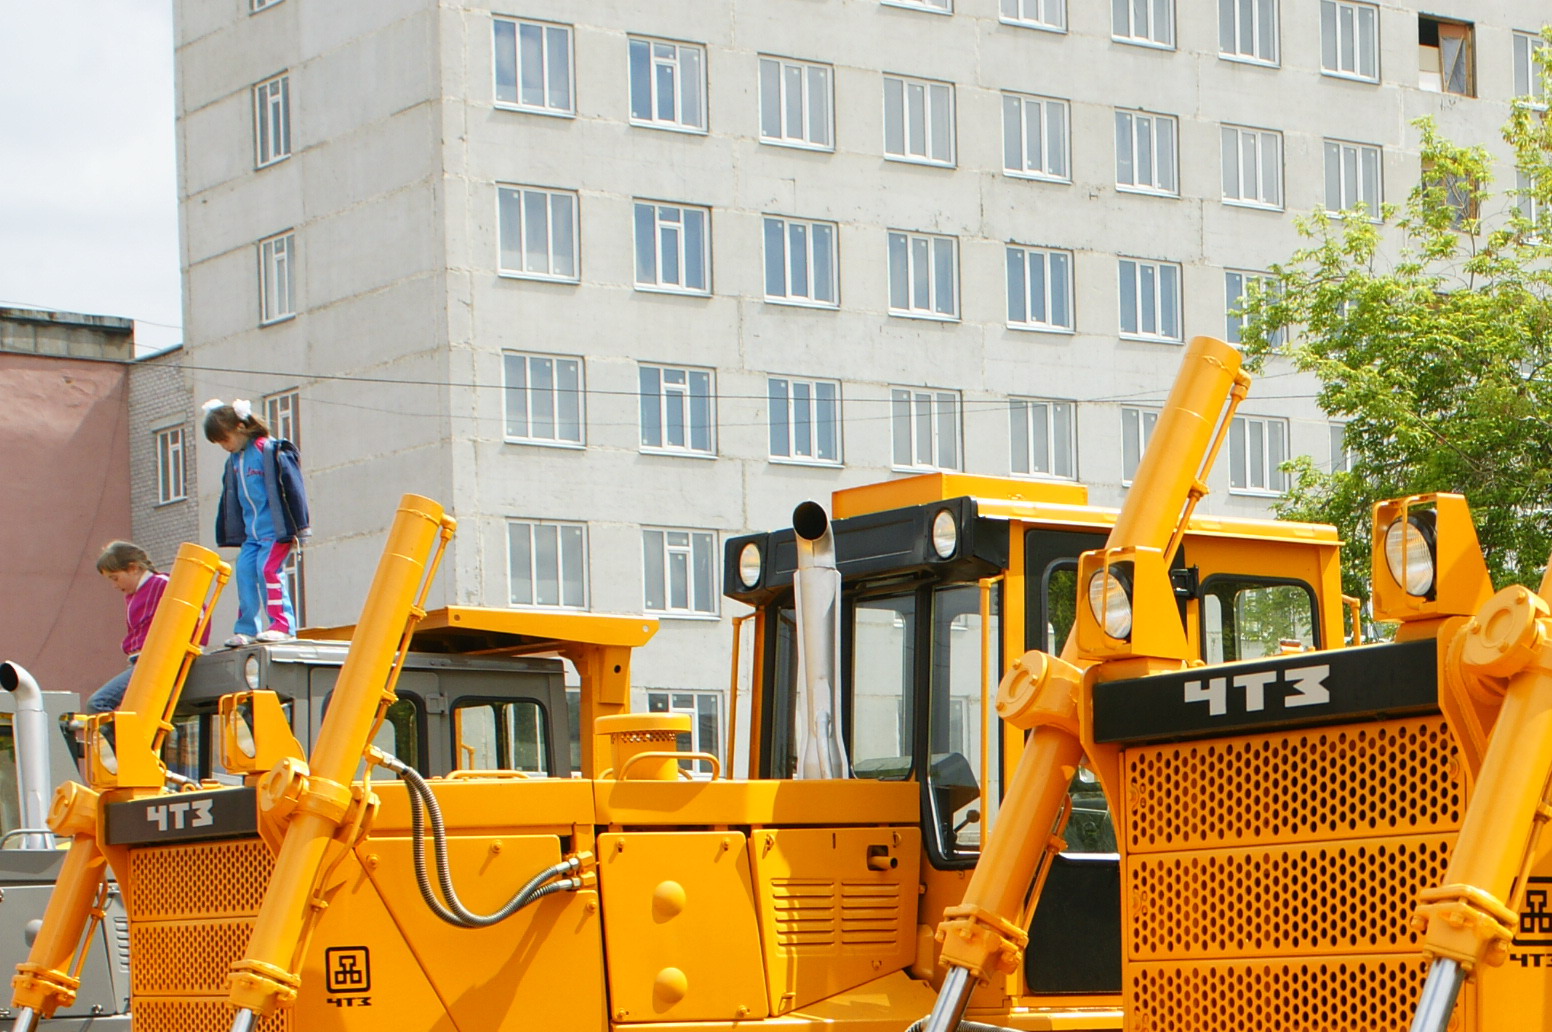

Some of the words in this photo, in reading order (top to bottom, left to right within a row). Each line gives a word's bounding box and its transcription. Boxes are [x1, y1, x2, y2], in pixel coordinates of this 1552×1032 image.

[1184, 664, 1330, 716] ЧТЗ
[147, 799, 214, 831] ЧТЗ
[327, 997, 372, 1007] ЧТЗ
